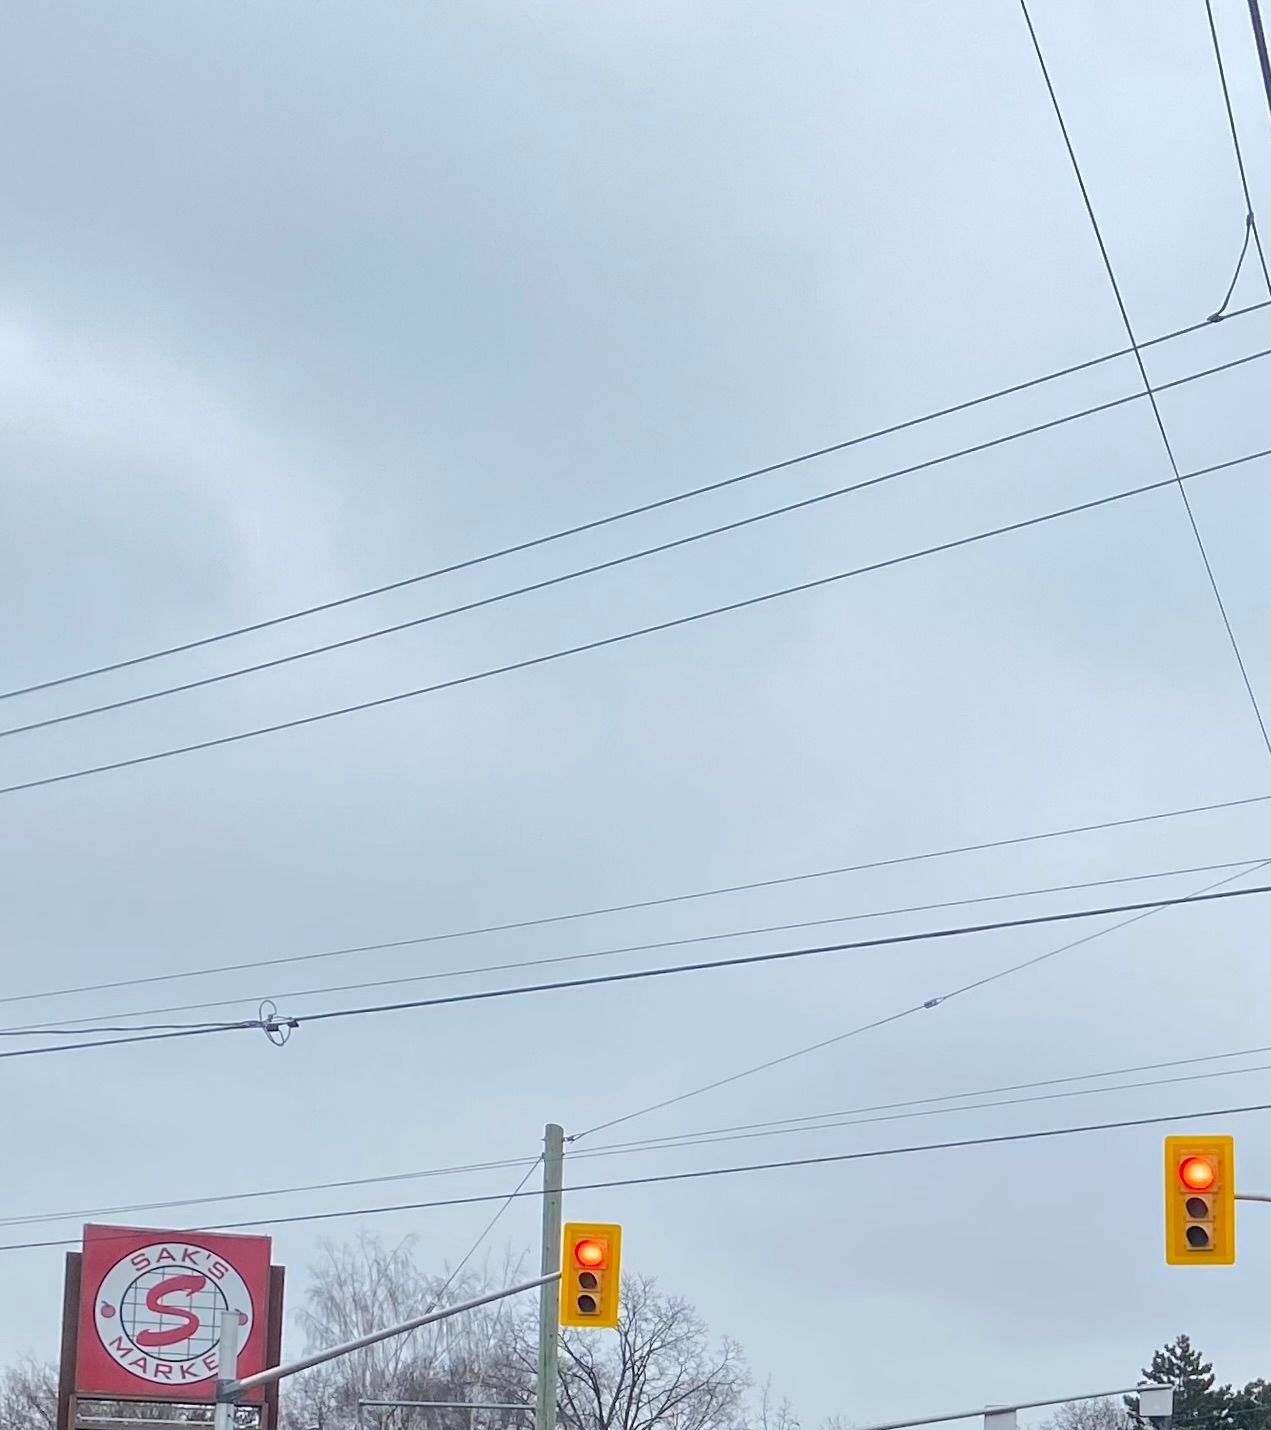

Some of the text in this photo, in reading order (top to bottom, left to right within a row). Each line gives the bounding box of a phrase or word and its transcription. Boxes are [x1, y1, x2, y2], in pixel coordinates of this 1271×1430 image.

[131, 1247, 229, 1280] SAK'S
[136, 1274, 207, 1347] S
[109, 1336, 220, 1380] MARKE
